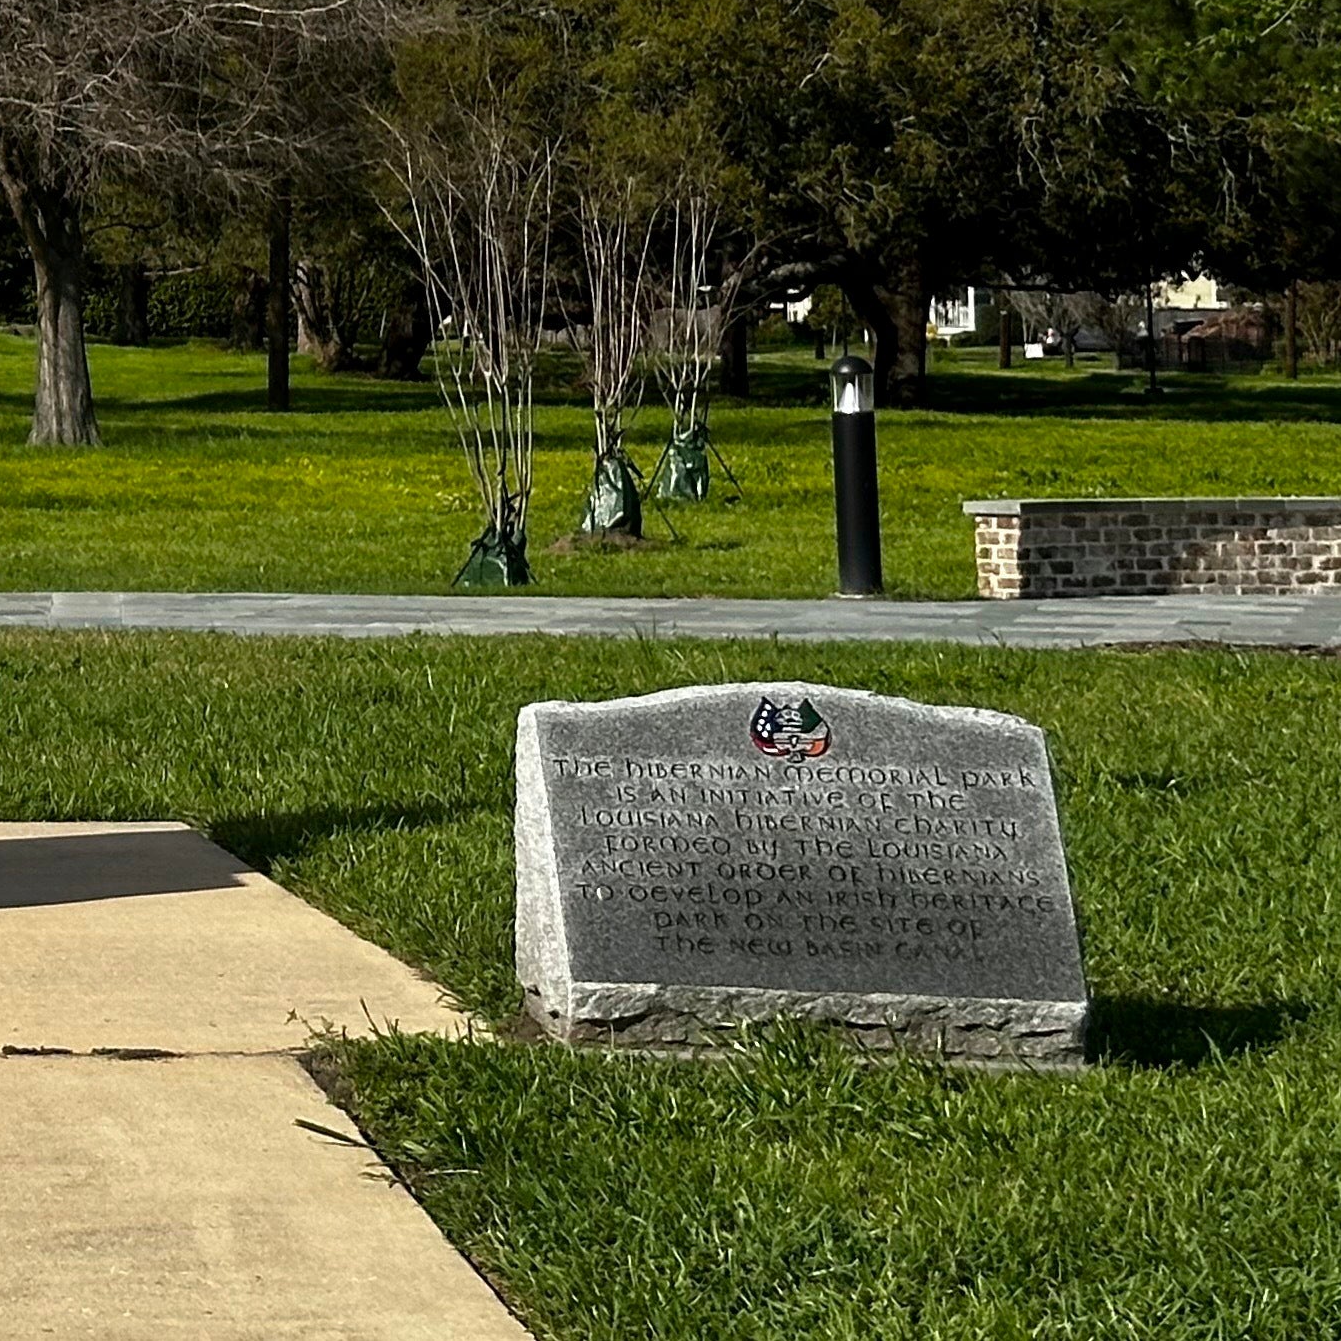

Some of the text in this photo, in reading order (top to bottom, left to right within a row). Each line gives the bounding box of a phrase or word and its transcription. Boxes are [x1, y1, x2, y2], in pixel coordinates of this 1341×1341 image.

[553, 759, 612, 777] THE
[962, 768, 1036, 790] PARK
[617, 786, 965, 812] IS AN INITIATIVE OF THE
[582, 806, 719, 827] LOUISIANA
[747, 839, 778, 860] BY
[795, 838, 853, 858] THE
[868, 838, 1007, 861] LOUISIANA
[581, 860, 702, 878] ANCIENT
[718, 862, 813, 882] ORDER
[828, 865, 863, 886] OF
[576, 884, 614, 901] TO
[776, 891, 814, 904] AN
[828, 888, 896, 908] IRISH
[654, 912, 728, 931] PARK
[745, 913, 784, 931] ON
[871, 917, 934, 935] SITE
[947, 919, 984, 940] OF
[654, 935, 715, 954] THE
[728, 938, 792, 956] NEW
